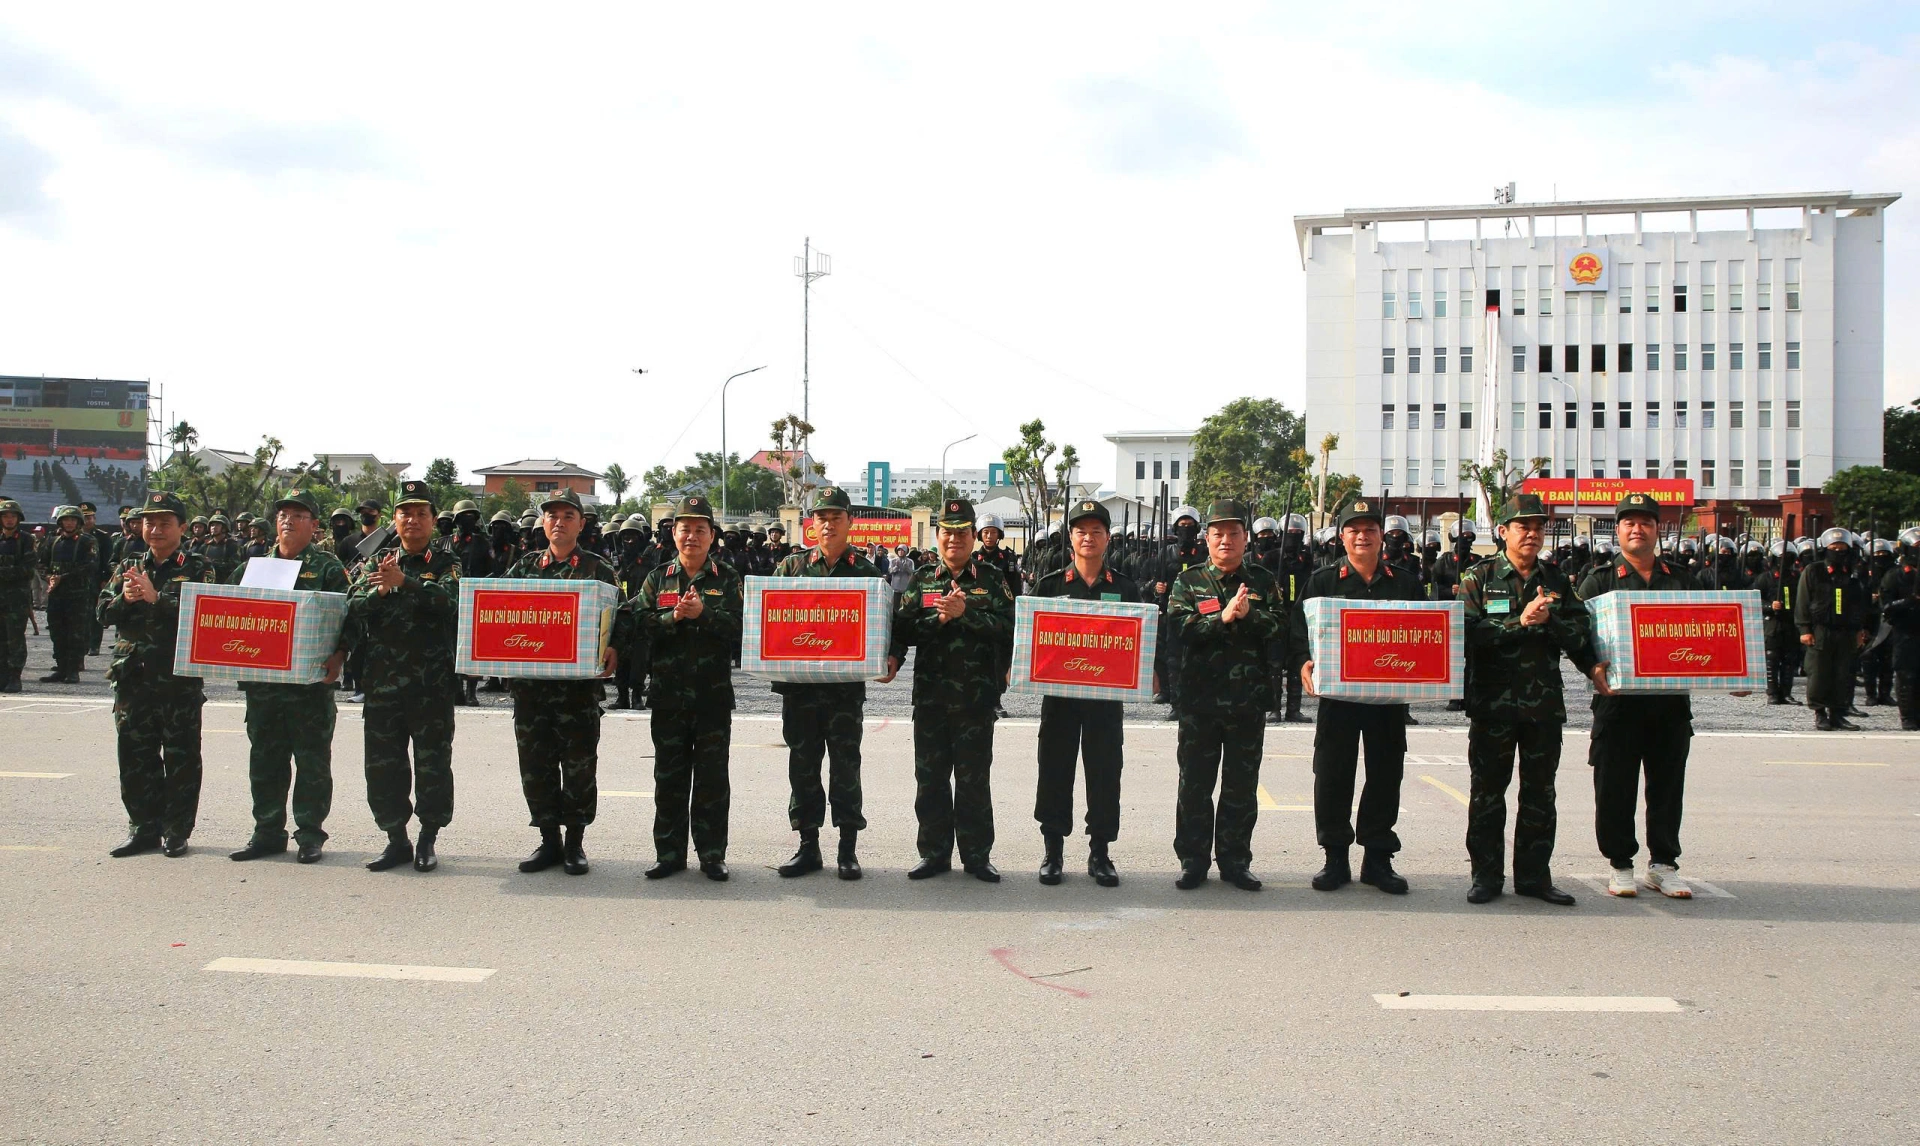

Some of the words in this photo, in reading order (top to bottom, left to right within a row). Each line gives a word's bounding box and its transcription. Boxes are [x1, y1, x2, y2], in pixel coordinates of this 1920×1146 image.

[1549, 491, 1574, 501] BAN
[1578, 489, 1612, 501] NHÂN
[1675, 492, 1685, 501] N
[883, 536, 896, 544] CHỤP
[898, 533, 909, 543] ẢNH
[200, 614, 213, 627] BAN
[215, 611, 226, 628] CHỈ
[227, 616, 239, 632] ĐẠO
[240, 613, 256, 630] DIỄN
[257, 616, 268, 634] TẬP
[270, 619, 287, 633] PT-26
[480, 610, 493, 623] BAN
[495, 606, 505, 623] CHỈ
[507, 610, 520, 626] ĐẠO
[522, 606, 537, 624] DIỄN
[539, 608, 551, 627] TẬP
[552, 611, 571, 624] PT-26
[768, 609, 781, 622] BAN
[783, 604, 794, 622] CHỈ
[795, 609, 808, 625] ĐẠO
[810, 604, 824, 622] DIỄN
[827, 607, 838, 625] TẬP
[841, 609, 858, 622] PT-26
[1348, 629, 1361, 642] BAN
[1363, 625, 1375, 643] CHỈ
[1377, 630, 1390, 646] ĐẠO
[1392, 625, 1407, 643] DIỄN
[1410, 627, 1421, 646] TẬP
[1424, 630, 1442, 643] PT-26
[1640, 624, 1654, 637] BAN
[1656, 619, 1667, 637] CHỈ
[1669, 624, 1682, 640] ĐẠO
[1685, 618, 1701, 637] DIỄN
[1702, 620, 1715, 640] TẬP
[1717, 624, 1737, 637] PT-26
[222, 640, 260, 658] Tặng
[504, 635, 544, 652] Tặng
[792, 633, 833, 650] Tặng
[1039, 631, 1053, 645] BAN
[1055, 628, 1066, 646] CHỈ
[1068, 633, 1080, 650] ĐẠO
[1082, 630, 1098, 648] DIỄN
[1100, 633, 1112, 652] TẬP
[1114, 636, 1133, 650] PT-26
[1374, 654, 1416, 672] Tặng
[1669, 648, 1711, 666] Tặng
[1064, 658, 1105, 676] Tặng
